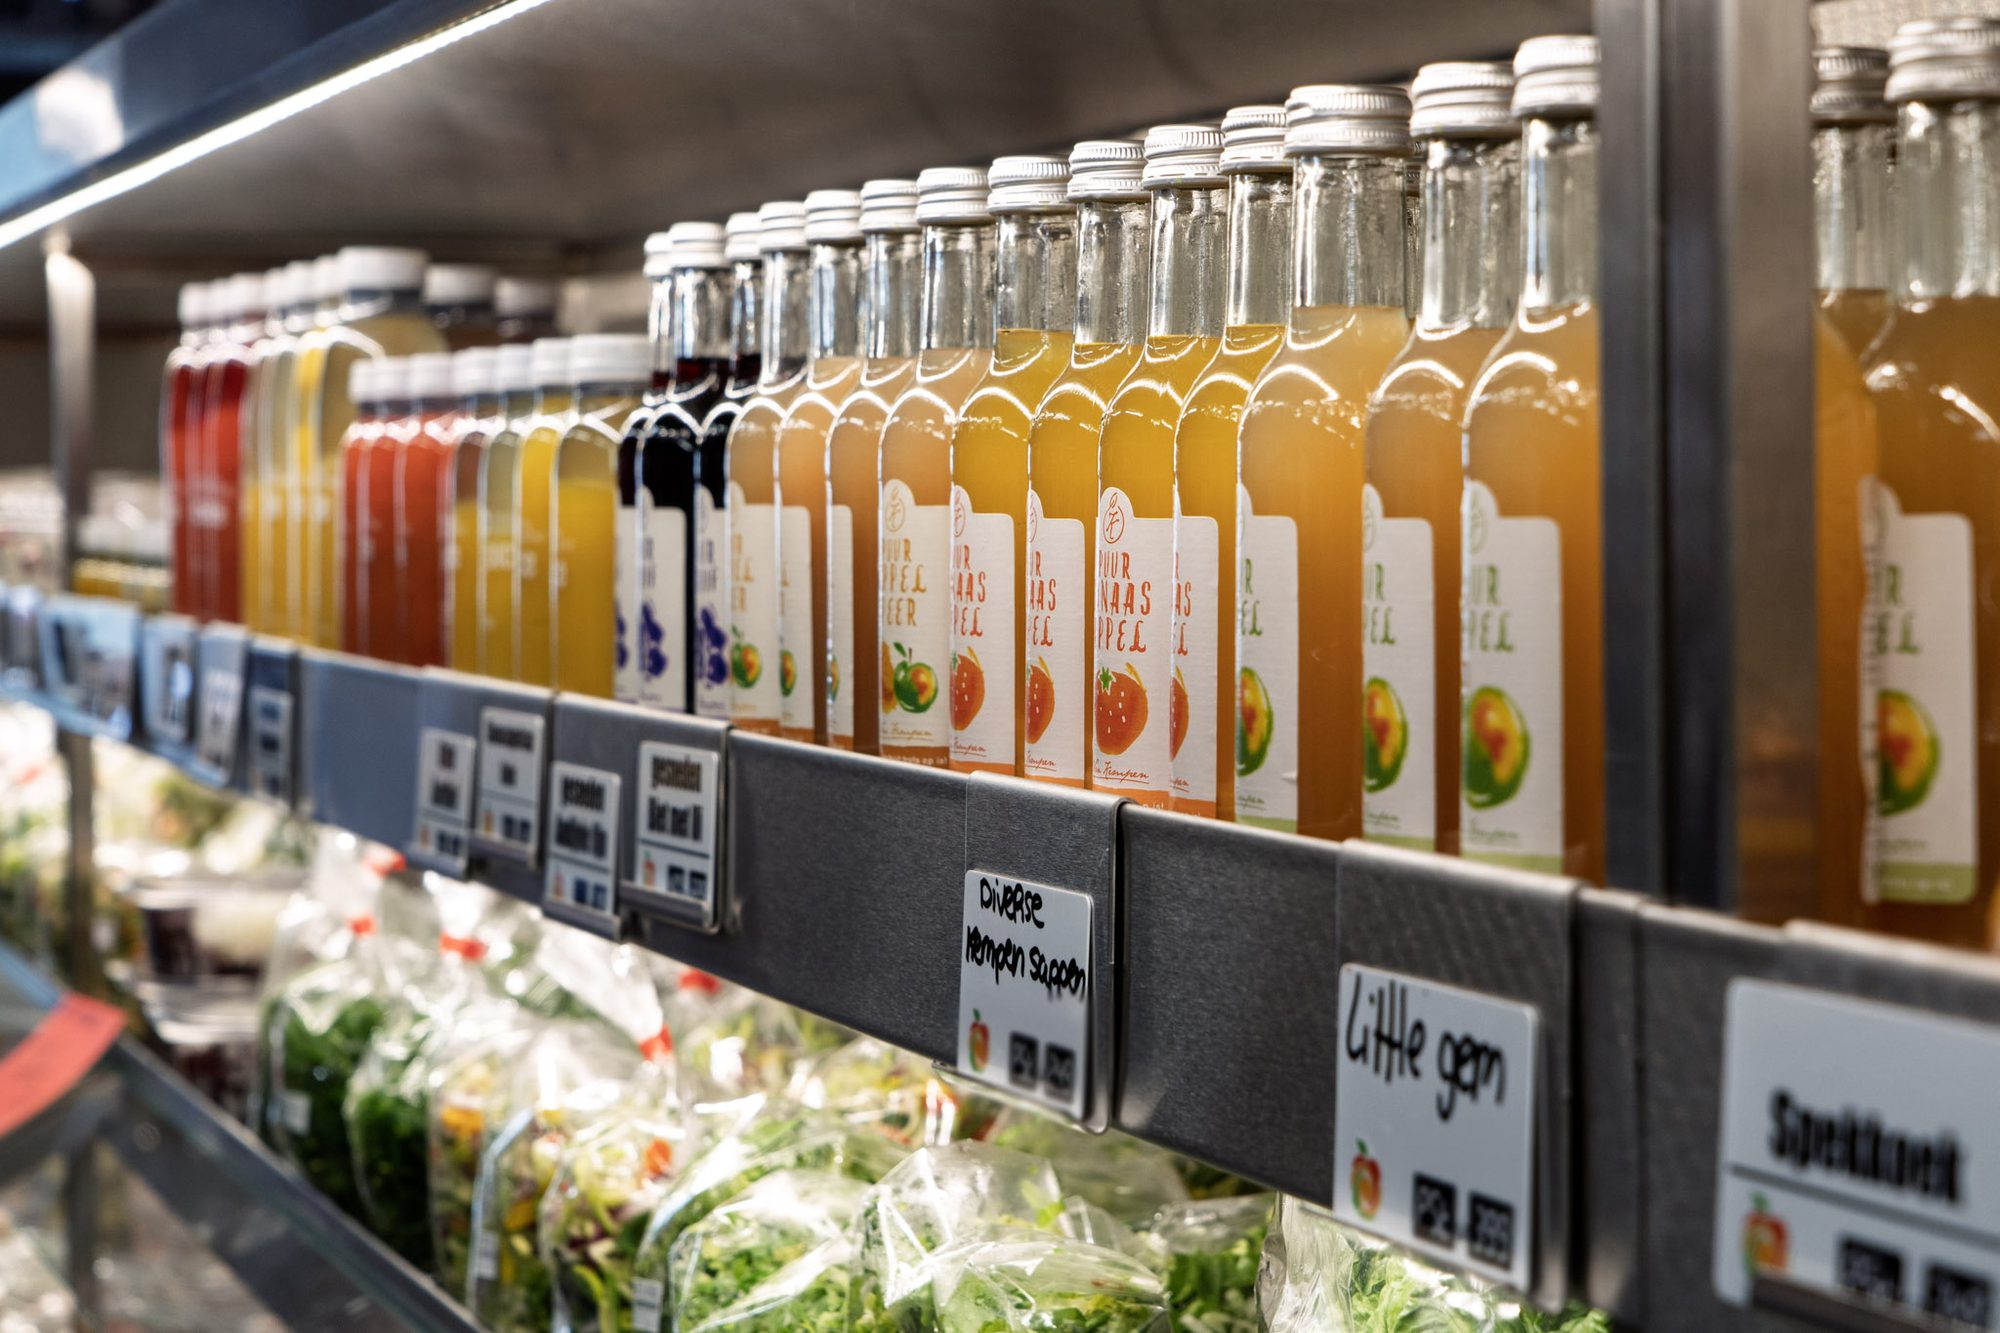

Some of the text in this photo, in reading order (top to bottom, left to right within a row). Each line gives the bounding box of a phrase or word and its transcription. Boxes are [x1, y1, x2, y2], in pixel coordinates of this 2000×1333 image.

[956, 571, 987, 604] AAS
[886, 597, 917, 627] EER
[953, 604, 984, 638] PEL
[1346, 972, 1507, 1125] Little gem
